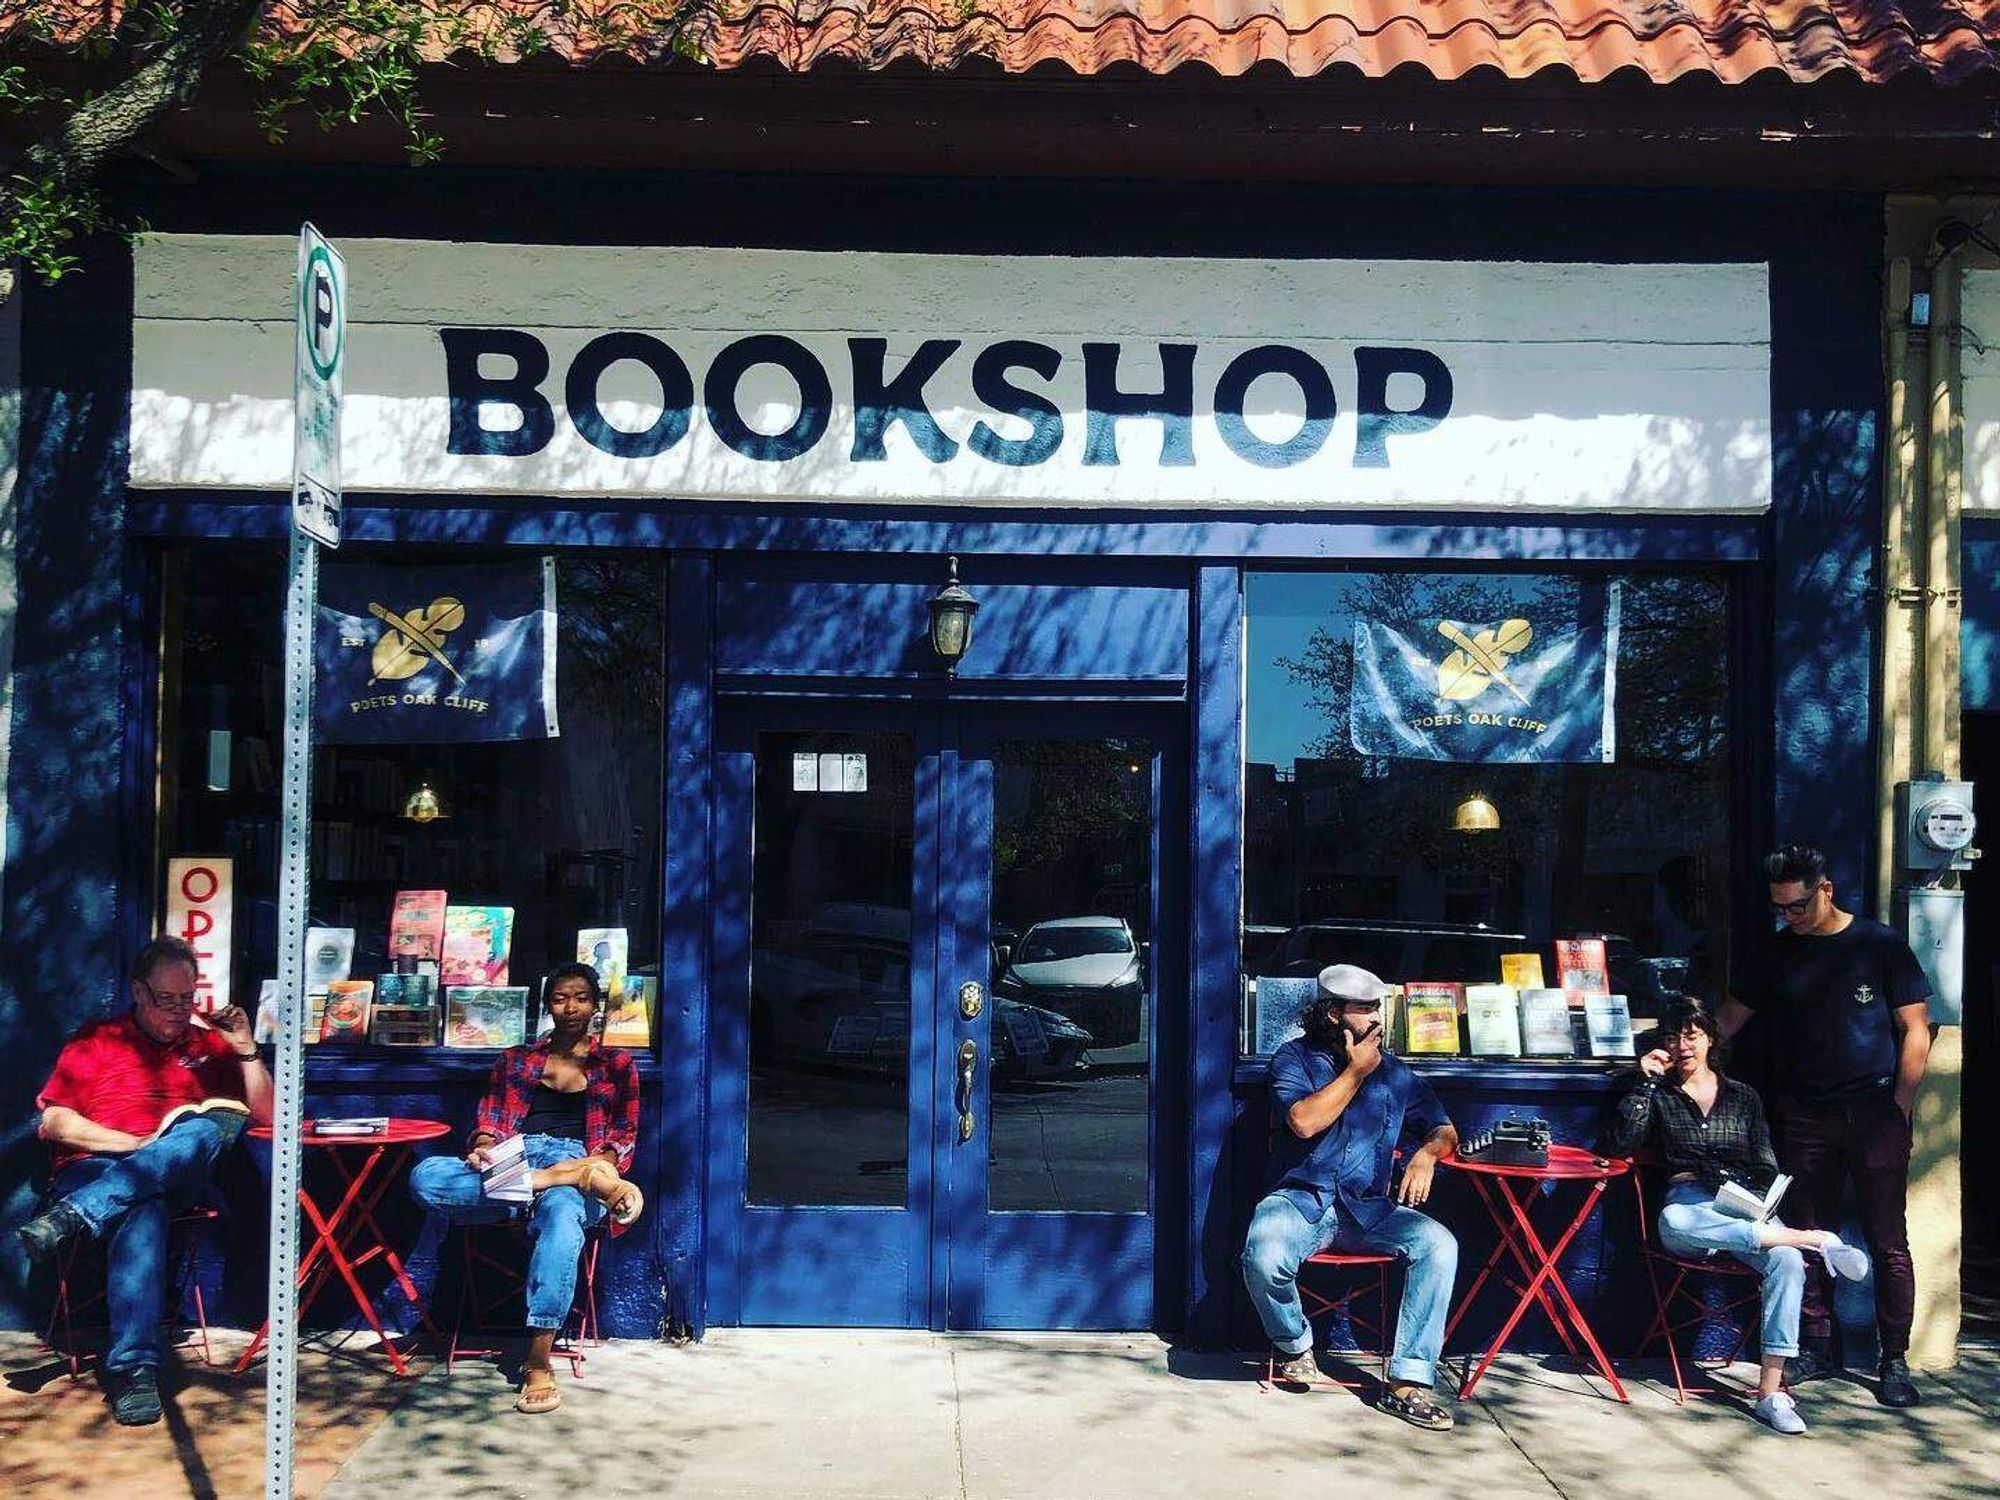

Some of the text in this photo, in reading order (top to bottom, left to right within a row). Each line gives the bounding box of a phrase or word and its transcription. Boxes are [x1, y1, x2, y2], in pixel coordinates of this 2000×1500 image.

[440, 328, 1454, 468] BOOKSHOP
[351, 694, 489, 713] POETS OAK CLIFF
[1413, 713, 1547, 734] POETS OAK CLIFF
